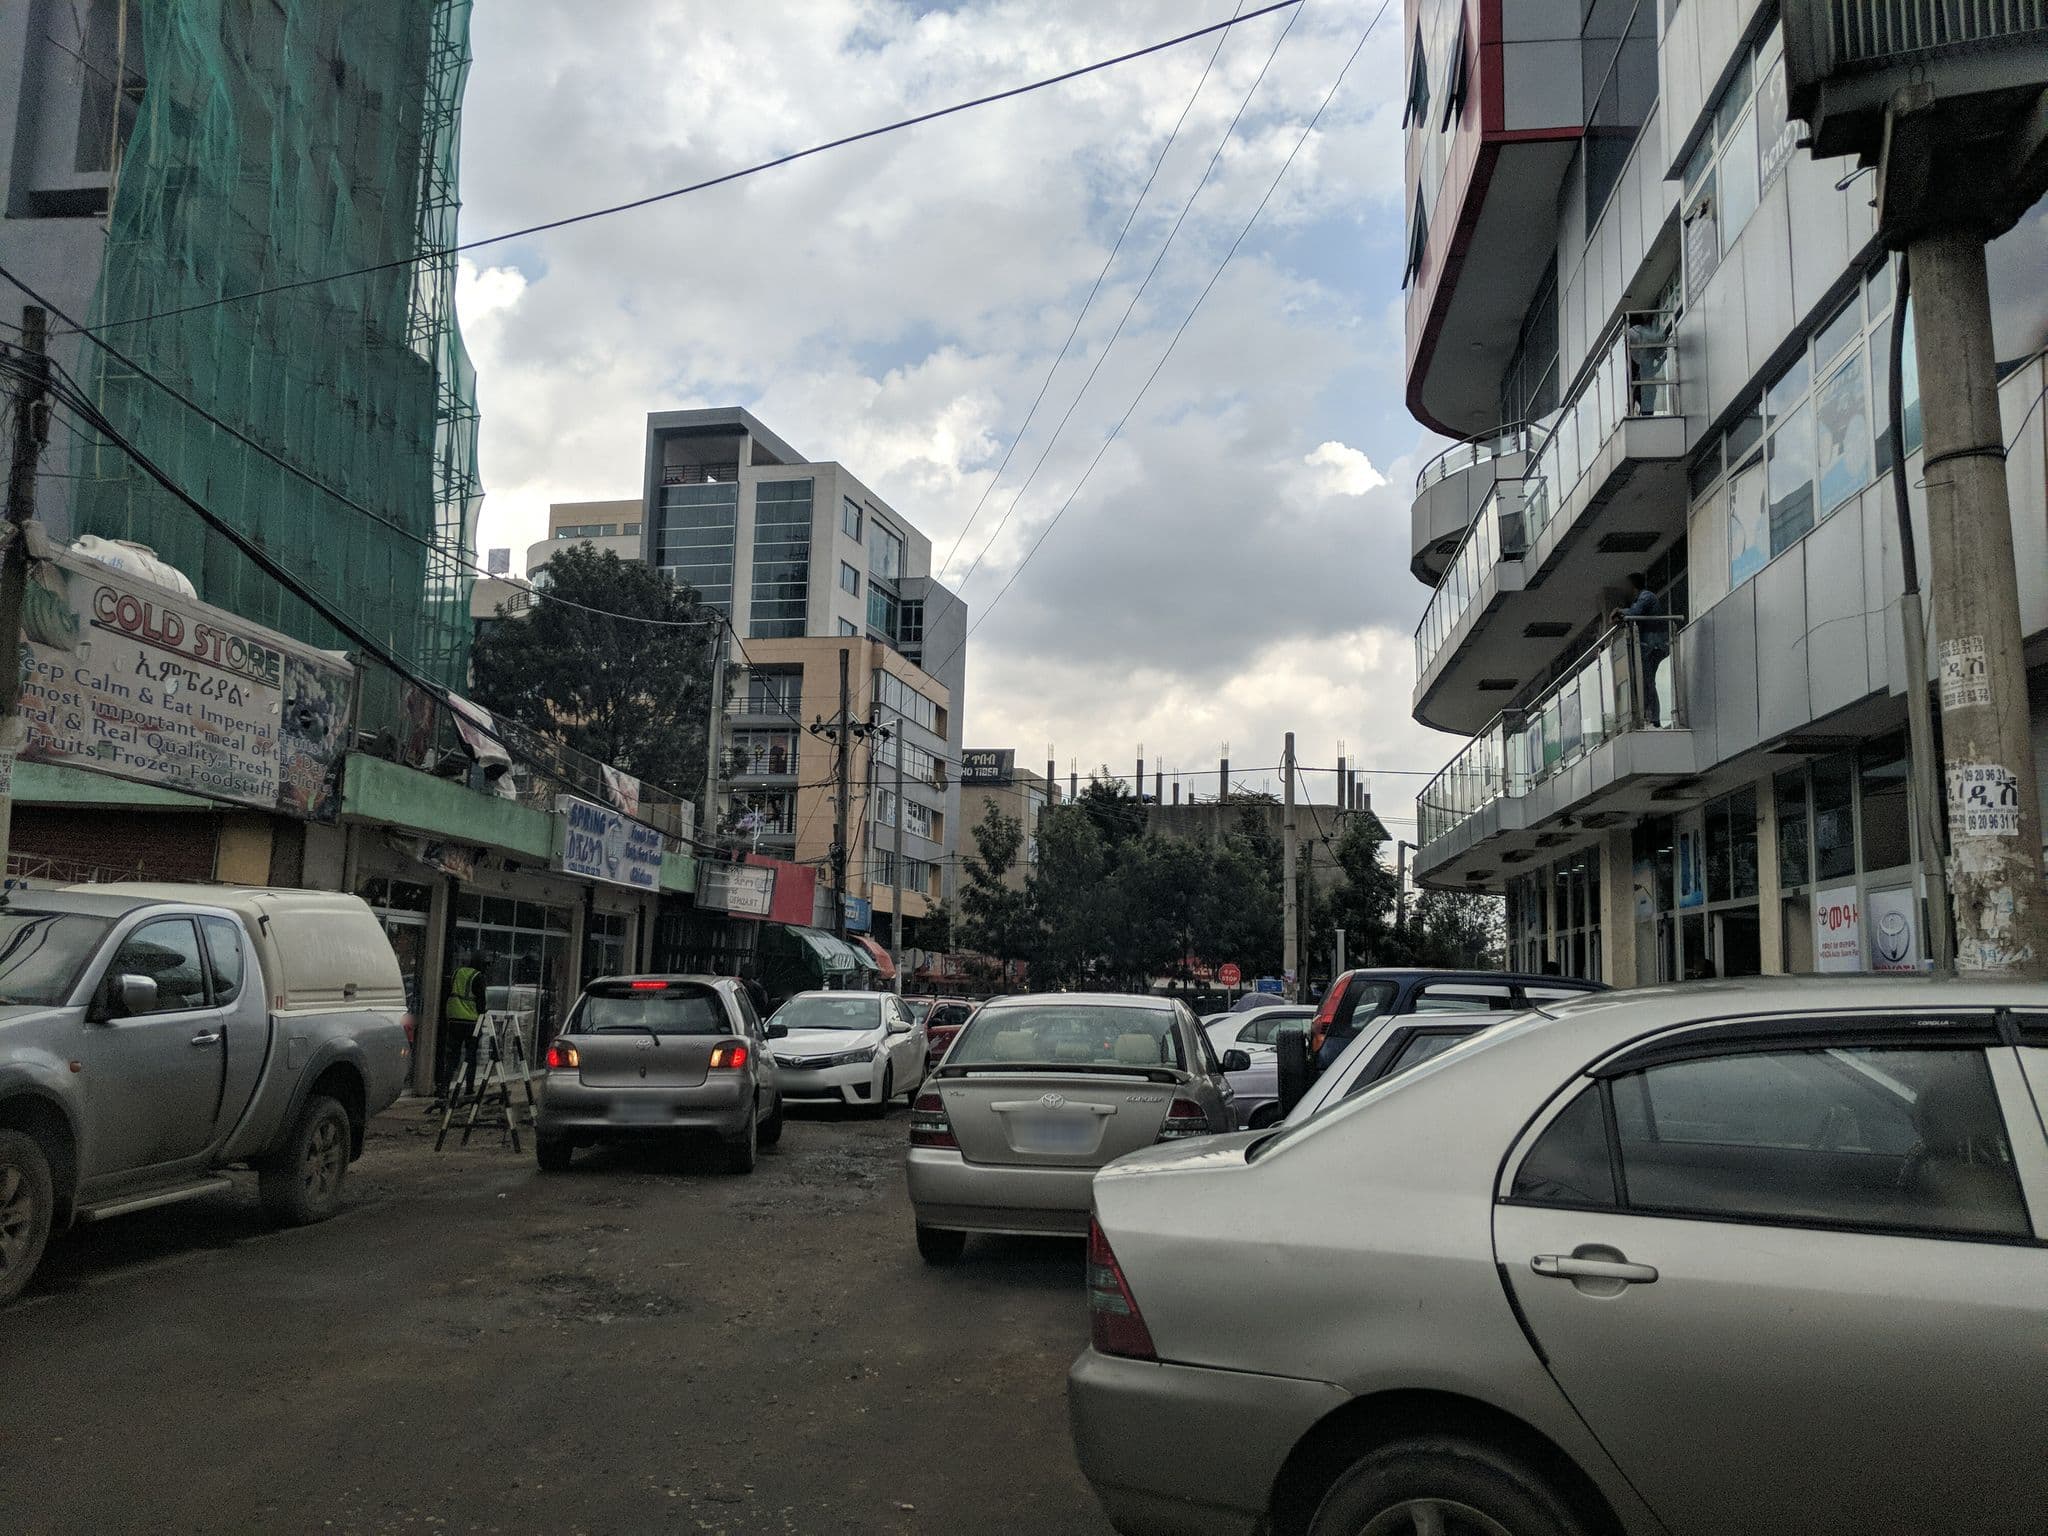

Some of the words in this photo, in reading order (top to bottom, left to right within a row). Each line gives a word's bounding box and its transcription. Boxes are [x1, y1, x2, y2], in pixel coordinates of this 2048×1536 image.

[93, 585, 185, 647] COLD
[194, 622, 281, 684] STORE
[21, 650, 65, 682] eep
[75, 668, 130, 698] Calm
[139, 687, 154, 705] &
[163, 694, 193, 716] Eat
[200, 704, 271, 739] Imperial
[24, 681, 82, 708] most
[91, 695, 196, 738] important
[204, 730, 245, 751] meal
[251, 739, 273, 757] of
[26, 726, 101, 760] Fruits,
[113, 745, 181, 776] Frozen
[190, 763, 279, 800] Foodstuffs
[65, 712, 81, 731] &
[93, 718, 138, 744] Real
[147, 732, 222, 767] Quality,
[229, 752, 273, 778] Fresh
[1974, 769, 1984, 781] 20
[1985, 768, 1995, 781] 96
[1996, 768, 2006, 781] 31
[1978, 814, 1988, 829] 20
[2000, 814, 2009, 829] 31
